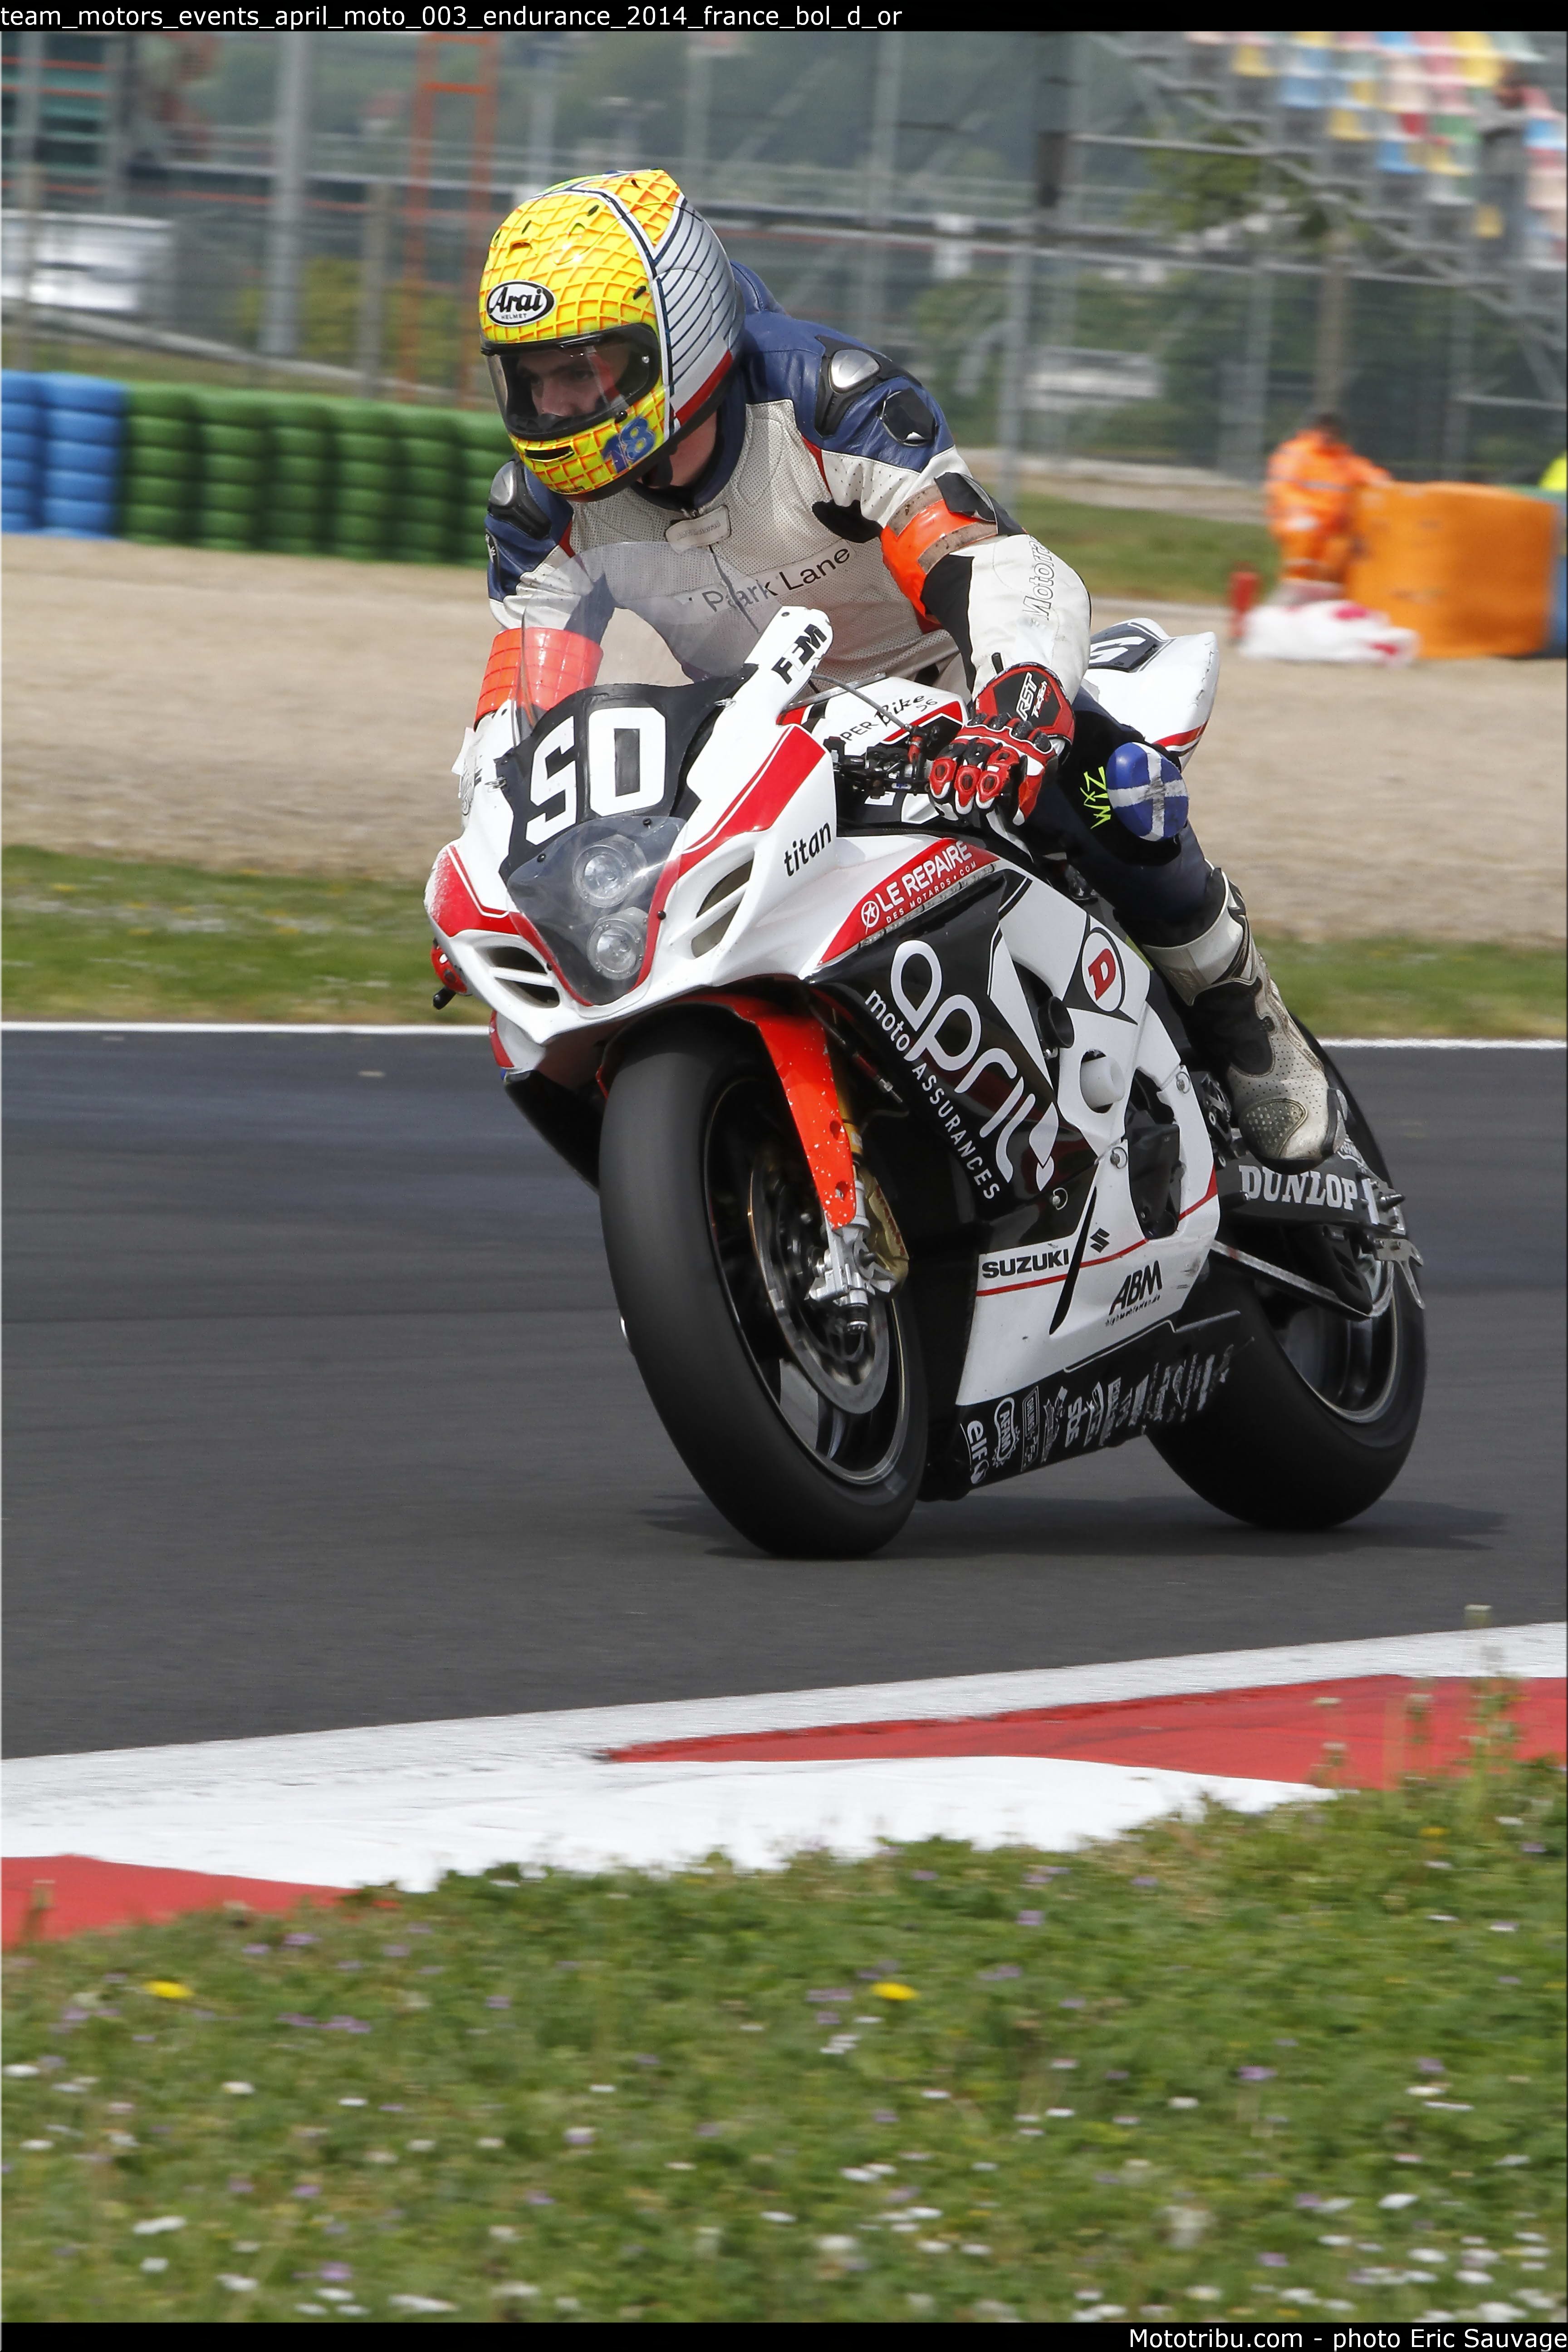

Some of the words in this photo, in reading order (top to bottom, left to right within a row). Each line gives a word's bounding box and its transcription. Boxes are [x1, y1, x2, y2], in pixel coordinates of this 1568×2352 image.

[490, 287, 543, 314] Arai
[602, 416, 655, 473] 18
[779, 548, 850, 590] Lane
[1016, 671, 1037, 721] RST
[525, 706, 666, 846] 50
[784, 822, 831, 877] titan
[875, 882, 904, 912] LE
[901, 840, 972, 897] REPAIRE
[886, 907, 904, 924] DES
[890, 940, 1036, 1183] april
[865, 990, 911, 1052] moto
[911, 1062, 1000, 1200] ASSURANCES
[1238, 1165, 1358, 1211] DUNLOP
[982, 1248, 1070, 1279] SUZUKI
[1108, 1260, 1163, 1316] ABM
[967, 1420, 988, 1460] elf
[1000, 1409, 1011, 1453] AFAM
